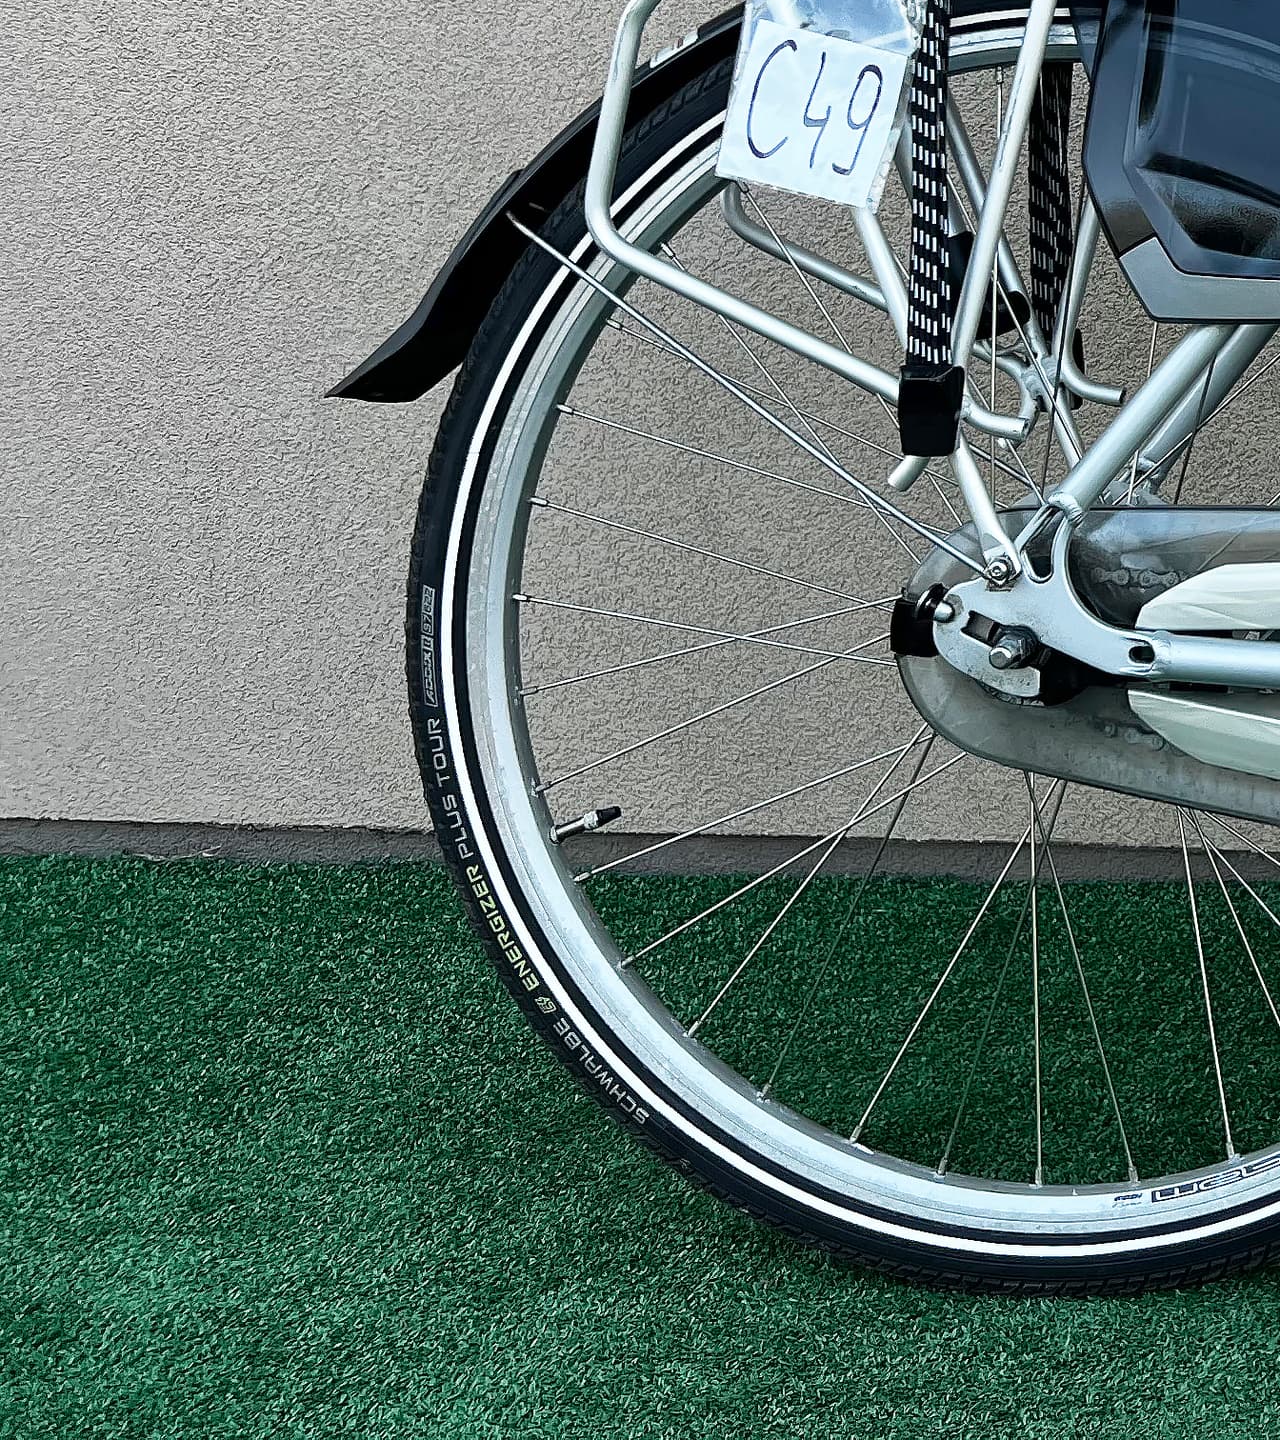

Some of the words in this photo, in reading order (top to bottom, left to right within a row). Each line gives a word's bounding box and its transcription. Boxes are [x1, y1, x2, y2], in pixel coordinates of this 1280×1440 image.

[426, 717, 451, 788] TOUR
[442, 793, 475, 860] PLUS
[466, 863, 540, 991] ENERGIZER
[552, 1017, 650, 1125] SCHWALBE
